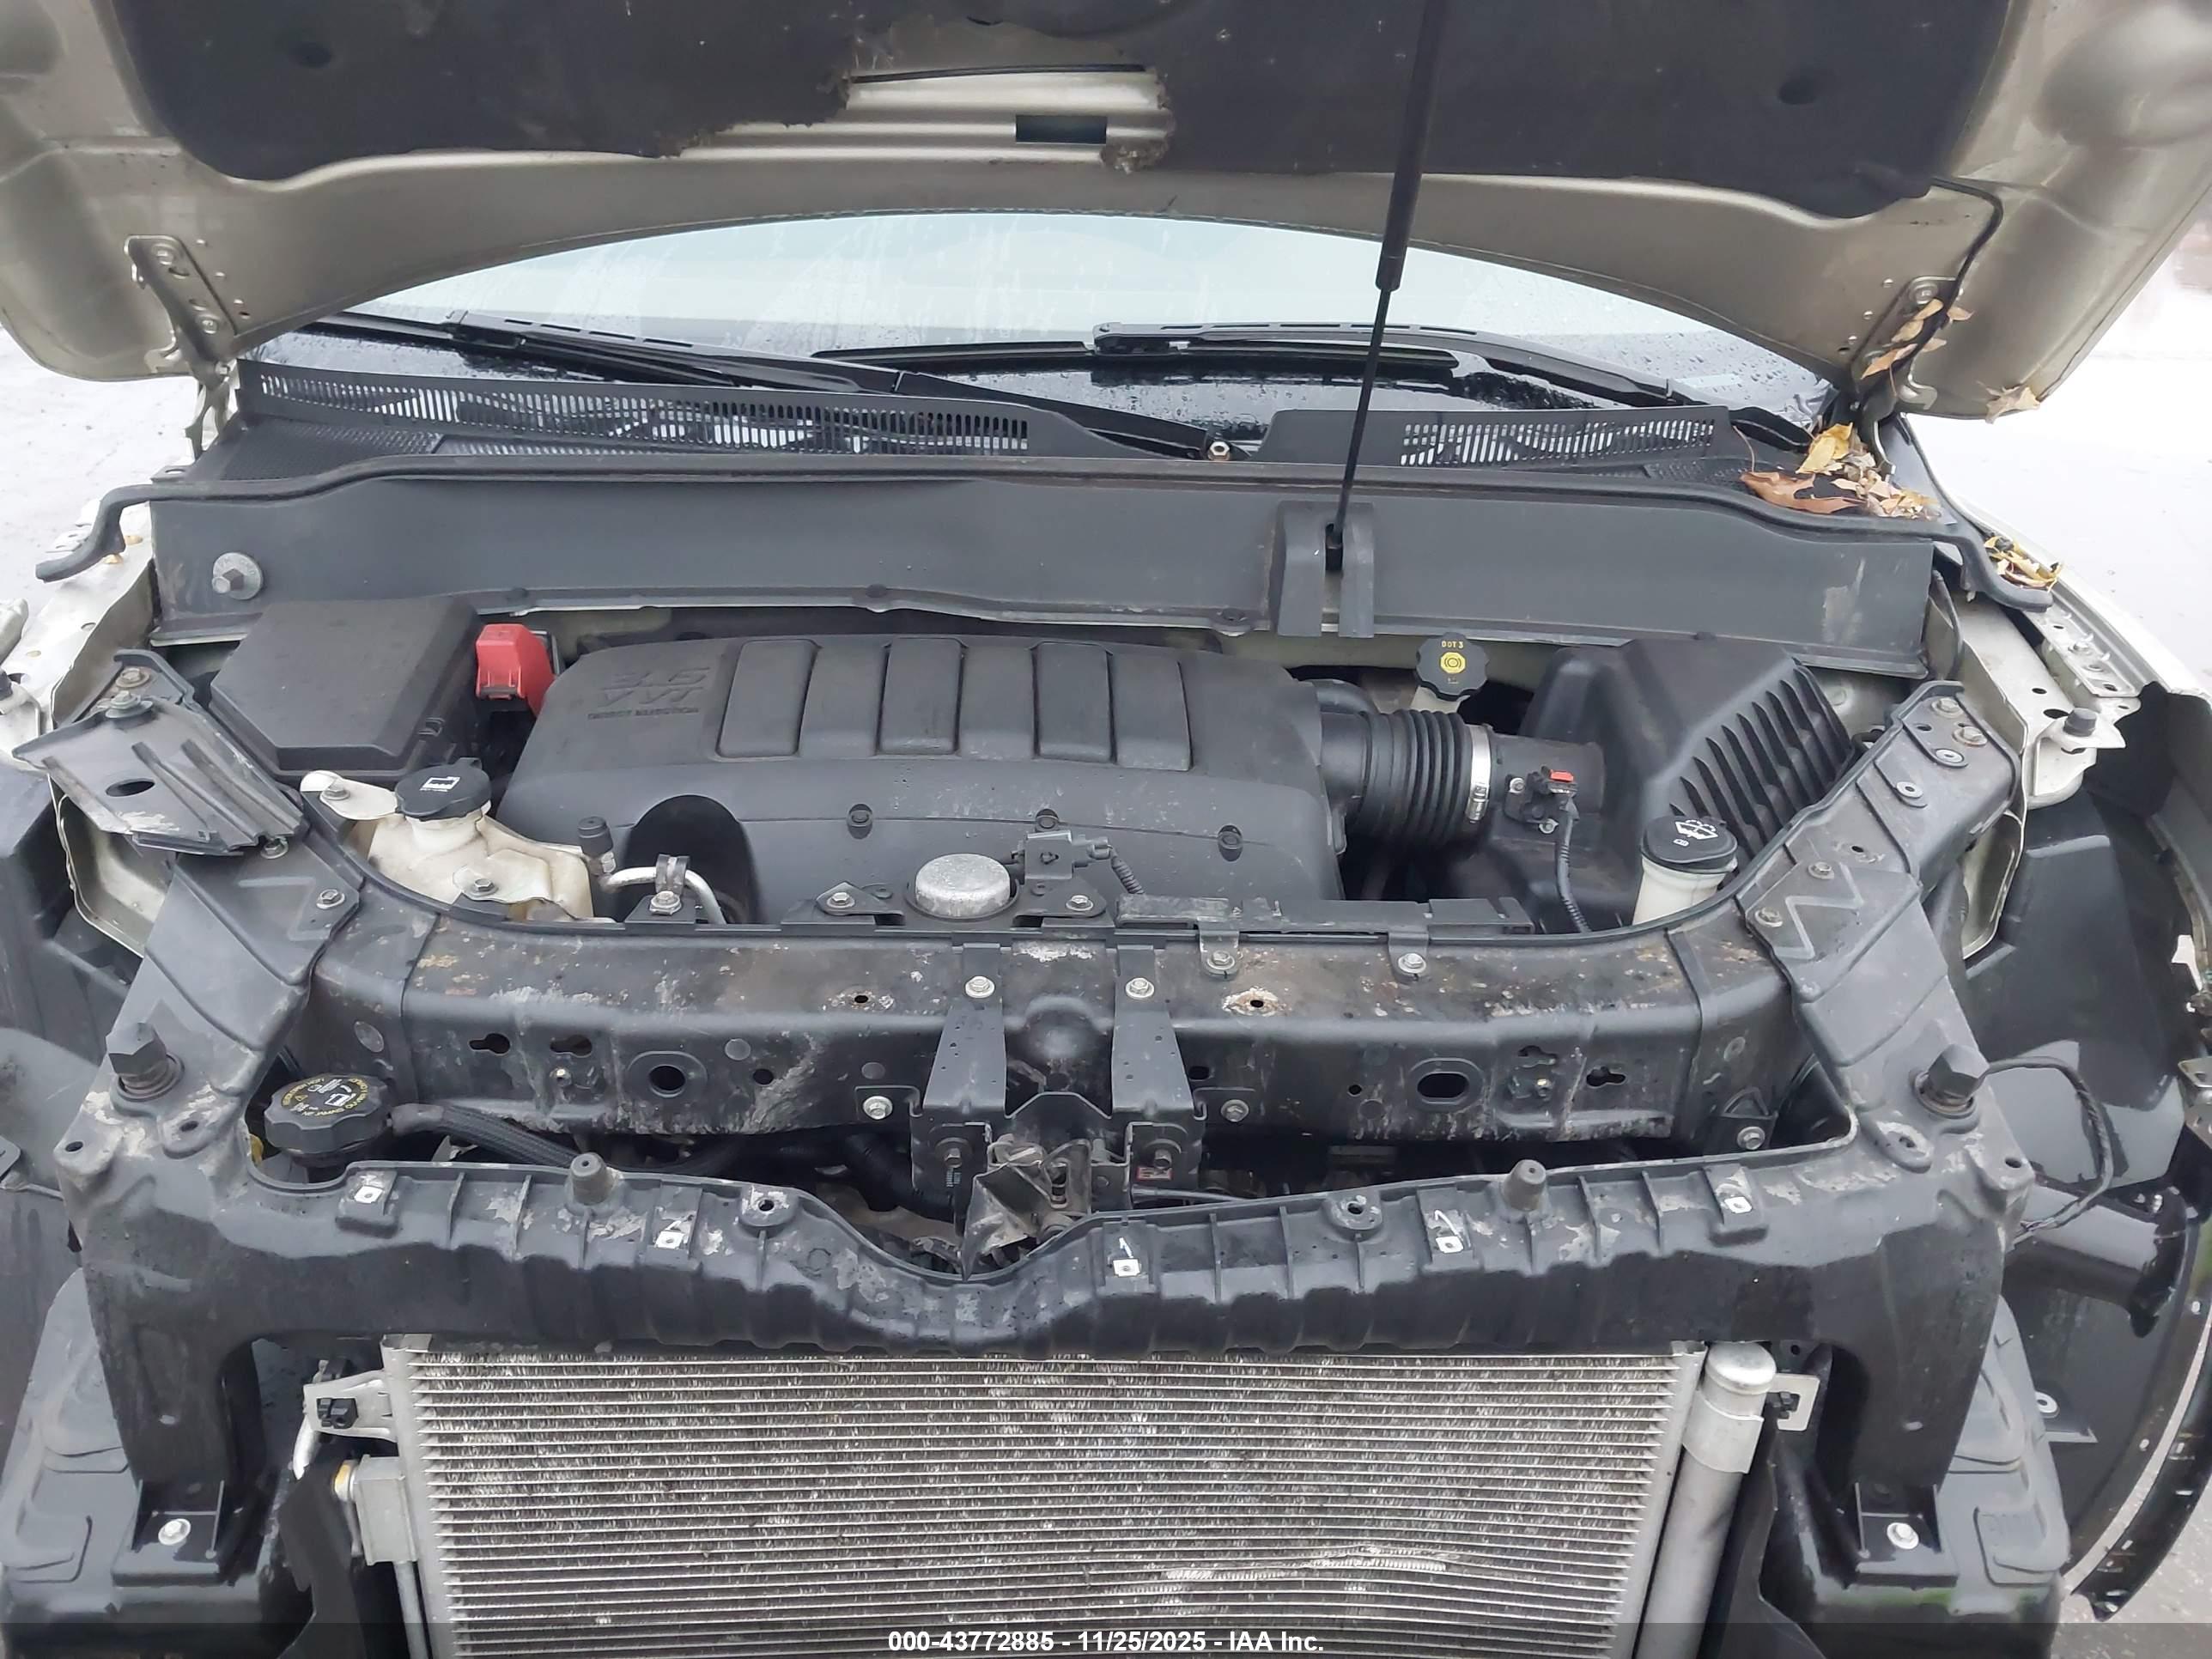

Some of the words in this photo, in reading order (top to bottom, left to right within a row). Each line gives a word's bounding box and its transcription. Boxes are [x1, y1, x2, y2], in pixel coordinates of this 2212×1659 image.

[1441, 640, 1457, 648] DOT
[1458, 641, 1464, 649] 3
[598, 686, 704, 708] VVT
